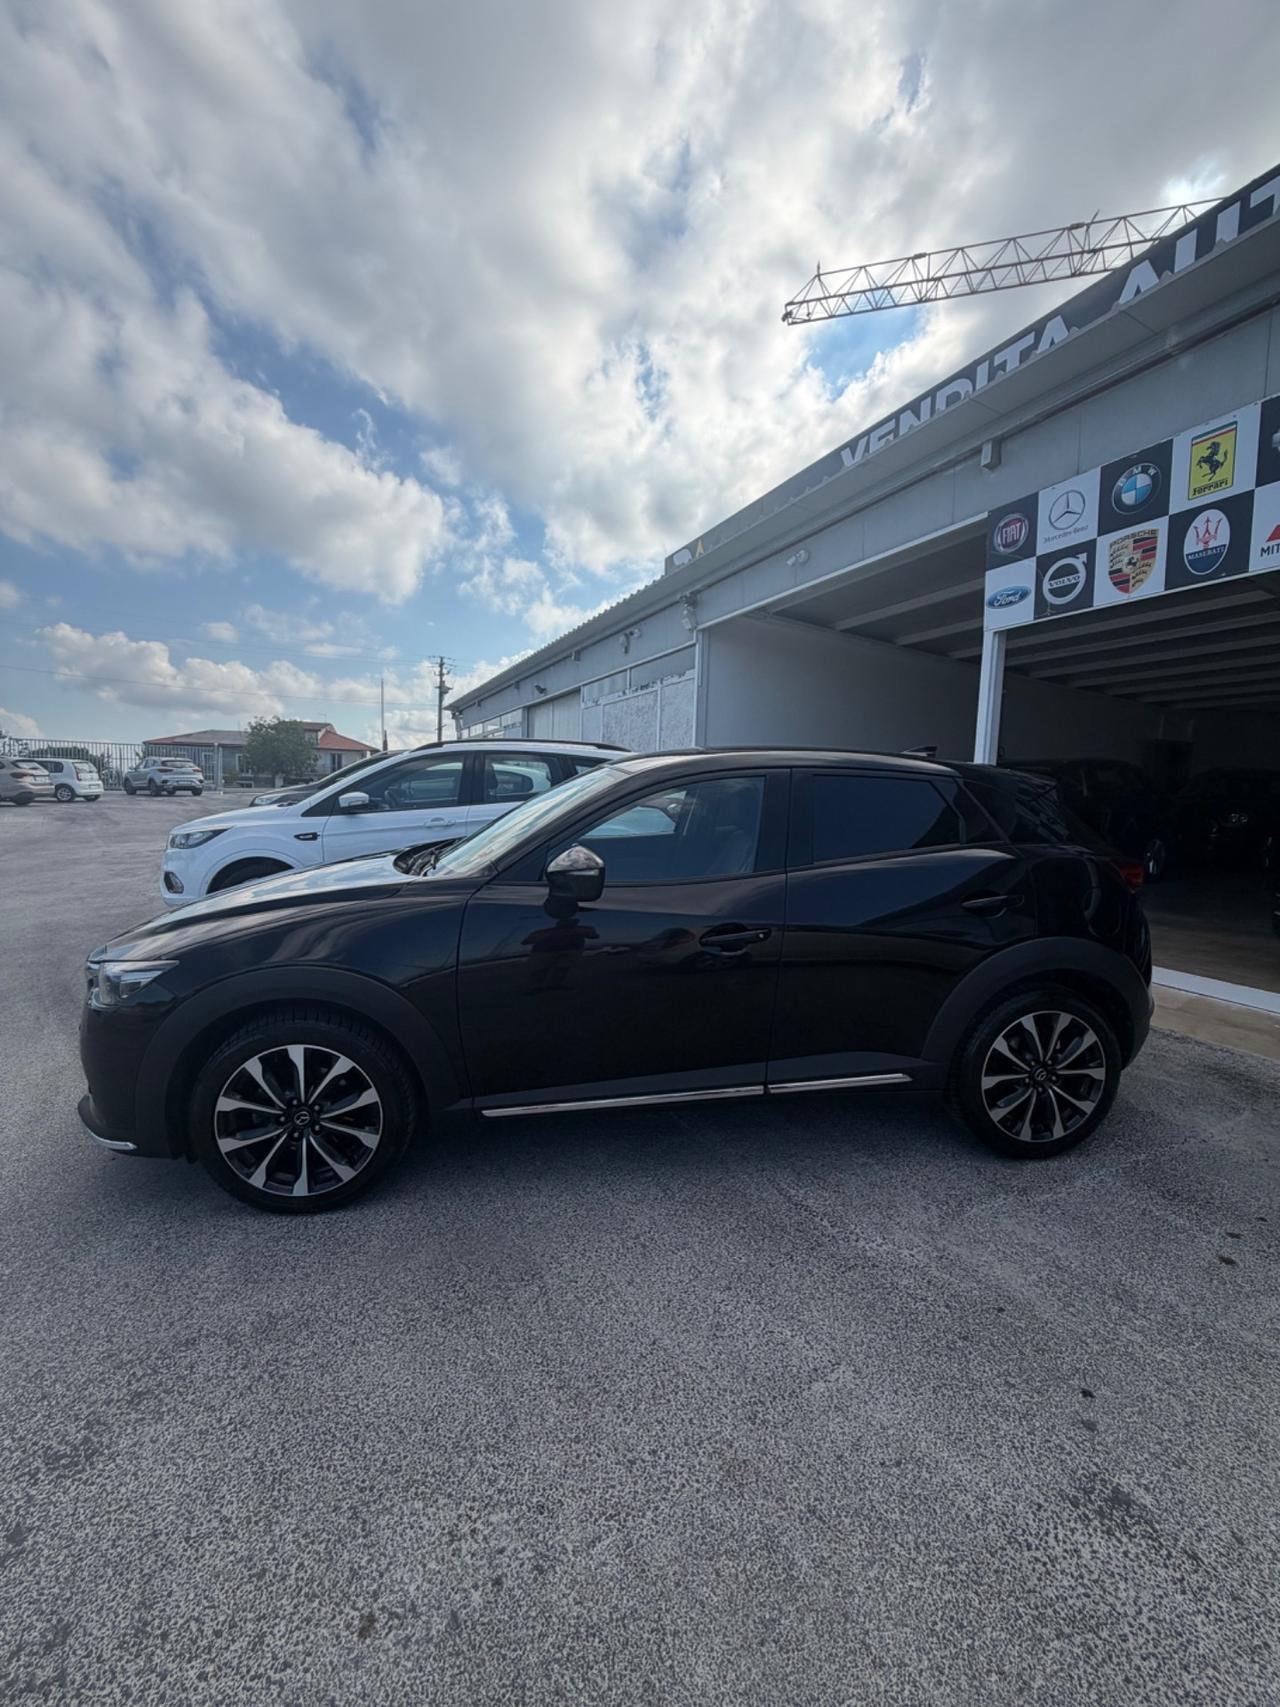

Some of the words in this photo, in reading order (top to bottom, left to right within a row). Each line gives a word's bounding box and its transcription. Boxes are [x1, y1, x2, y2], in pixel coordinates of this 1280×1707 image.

[1118, 464, 1158, 488] BMW
[1192, 477, 1229, 496] Ferrari
[1002, 520, 1022, 545] FIAT
[1048, 574, 1081, 588] VOLVO
[993, 591, 1022, 607] Ford
